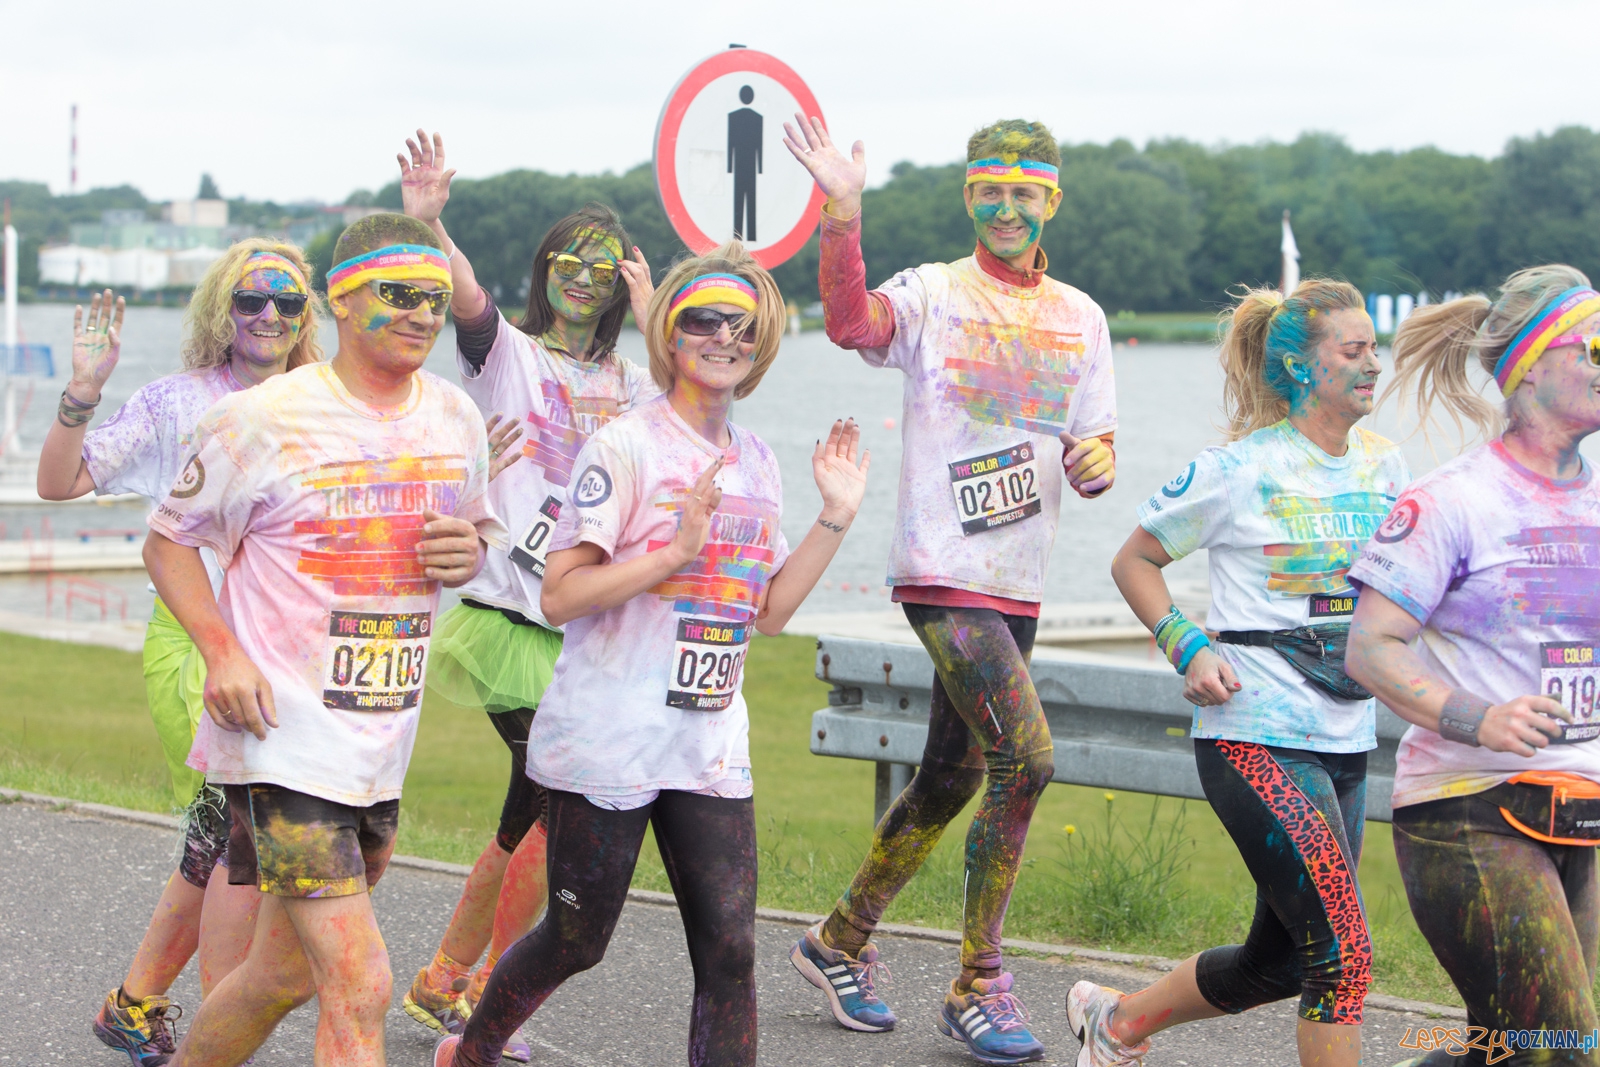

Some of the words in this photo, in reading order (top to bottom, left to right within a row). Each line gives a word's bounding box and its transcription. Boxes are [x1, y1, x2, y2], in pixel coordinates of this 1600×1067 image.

[379, 255, 398, 265] COLOR
[698, 280, 716, 289] COLOR
[955, 464, 972, 478] THE
[971, 457, 999, 474] COLOR
[998, 453, 1014, 468] RUN
[581, 477, 602, 498] PZU
[960, 468, 1037, 516] 02102
[322, 486, 361, 517] THE
[364, 483, 427, 514] COLOR
[986, 509, 1026, 528] #HAPPIEST5K
[1281, 515, 1321, 540] THE
[1320, 513, 1374, 539] COLOR
[525, 521, 550, 553] 0
[1524, 545, 1557, 565] THE
[1315, 600, 1330, 613] THE
[1330, 598, 1353, 612] COLOR
[340, 618, 358, 633] THE
[359, 619, 393, 635] COLOR
[394, 620, 412, 634] RUN
[685, 624, 703, 639] THE
[703, 627, 733, 642] COLOR
[1546, 648, 1564, 664] THE
[1564, 647, 1593, 664] COLOR
[332, 644, 424, 687] 02103
[356, 695, 405, 707] #HAPPIEST5K
